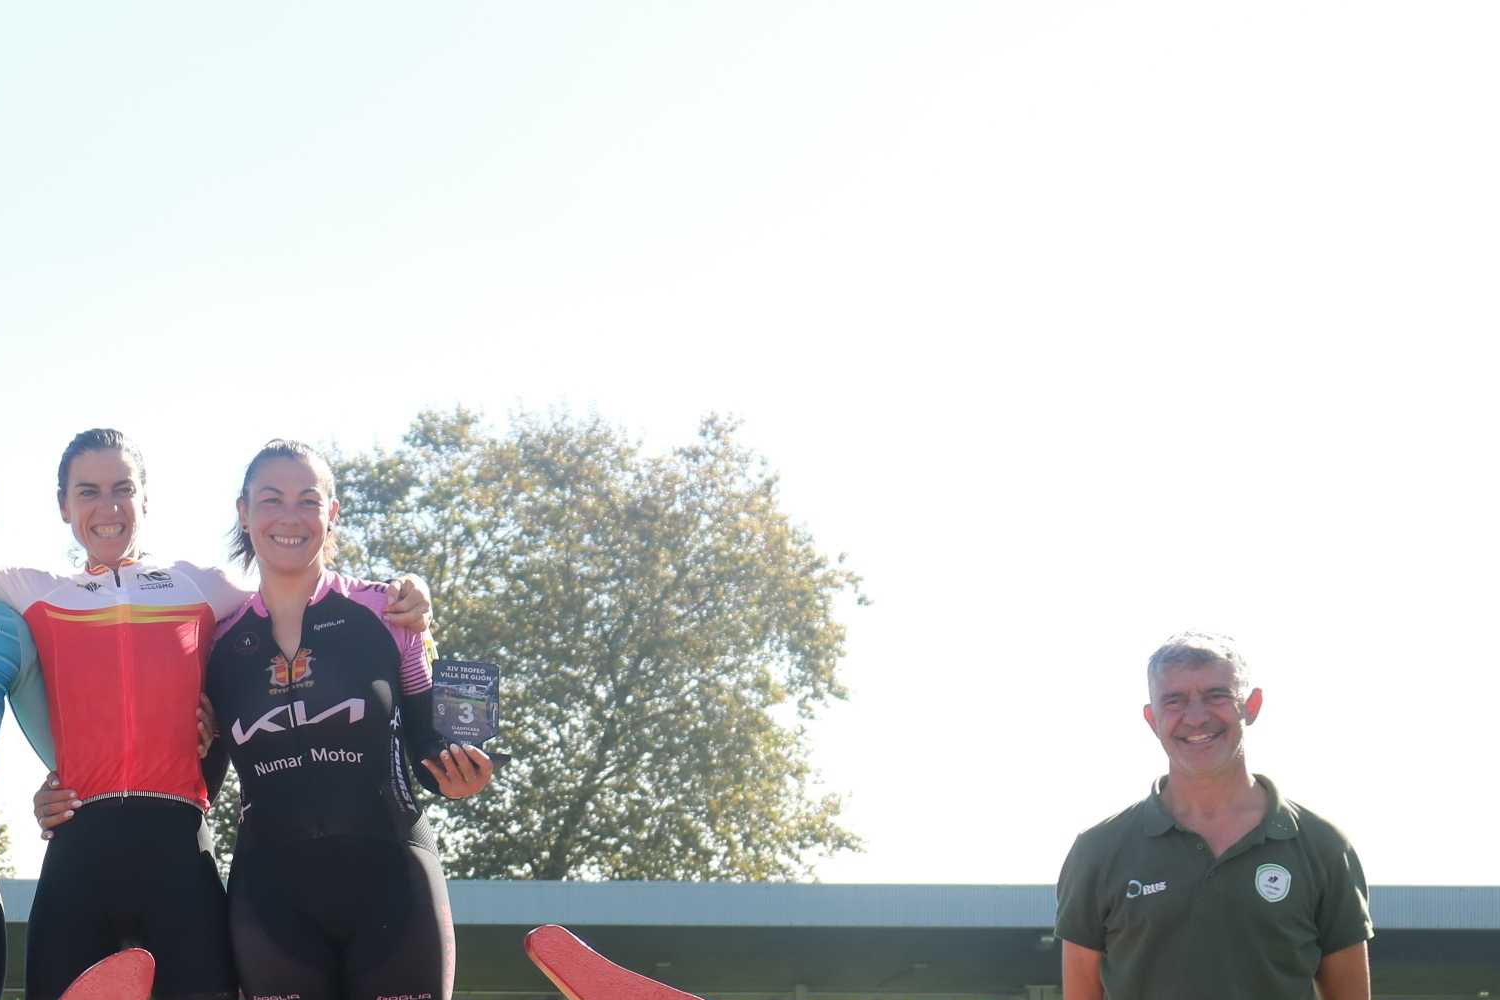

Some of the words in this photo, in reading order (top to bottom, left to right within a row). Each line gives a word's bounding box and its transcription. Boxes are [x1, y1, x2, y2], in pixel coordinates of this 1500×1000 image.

[440, 671, 459, 679] VILLA
[470, 673, 492, 681] GIJÓN
[460, 666, 486, 674] TROFEO
[458, 703, 475, 724] 3
[253, 755, 303, 777] Numar
[310, 747, 364, 764] Motor
